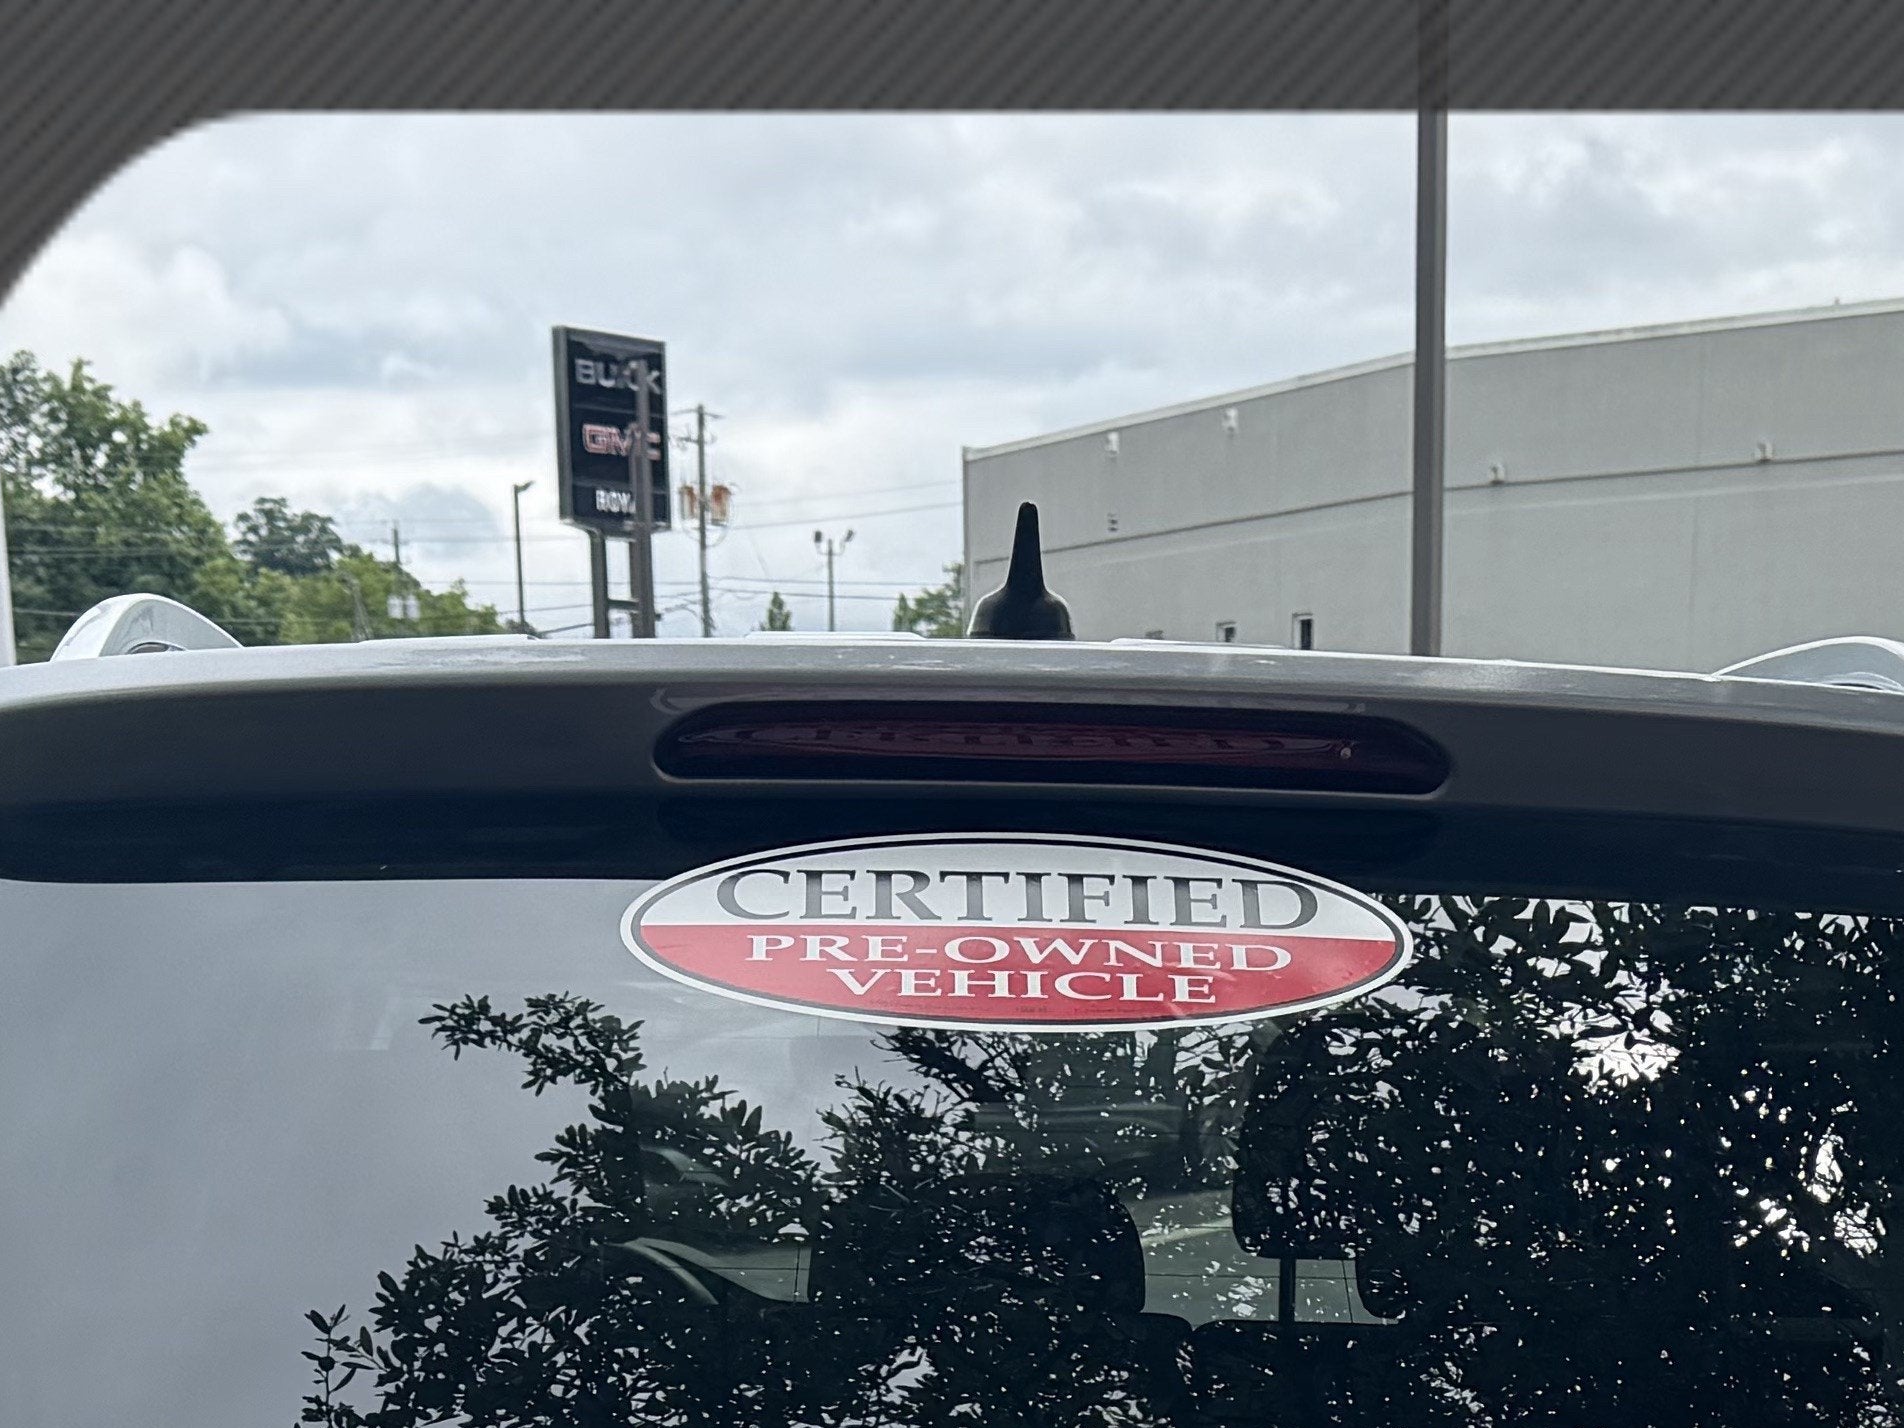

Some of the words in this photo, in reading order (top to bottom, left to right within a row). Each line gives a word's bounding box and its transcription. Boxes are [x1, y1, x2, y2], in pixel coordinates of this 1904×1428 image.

[595, 488, 637, 514] ROY
[715, 867, 1320, 932] CERTIFIED
[744, 932, 1294, 973] PRE-OWNED
[826, 967, 1218, 1005] VEHICLE
